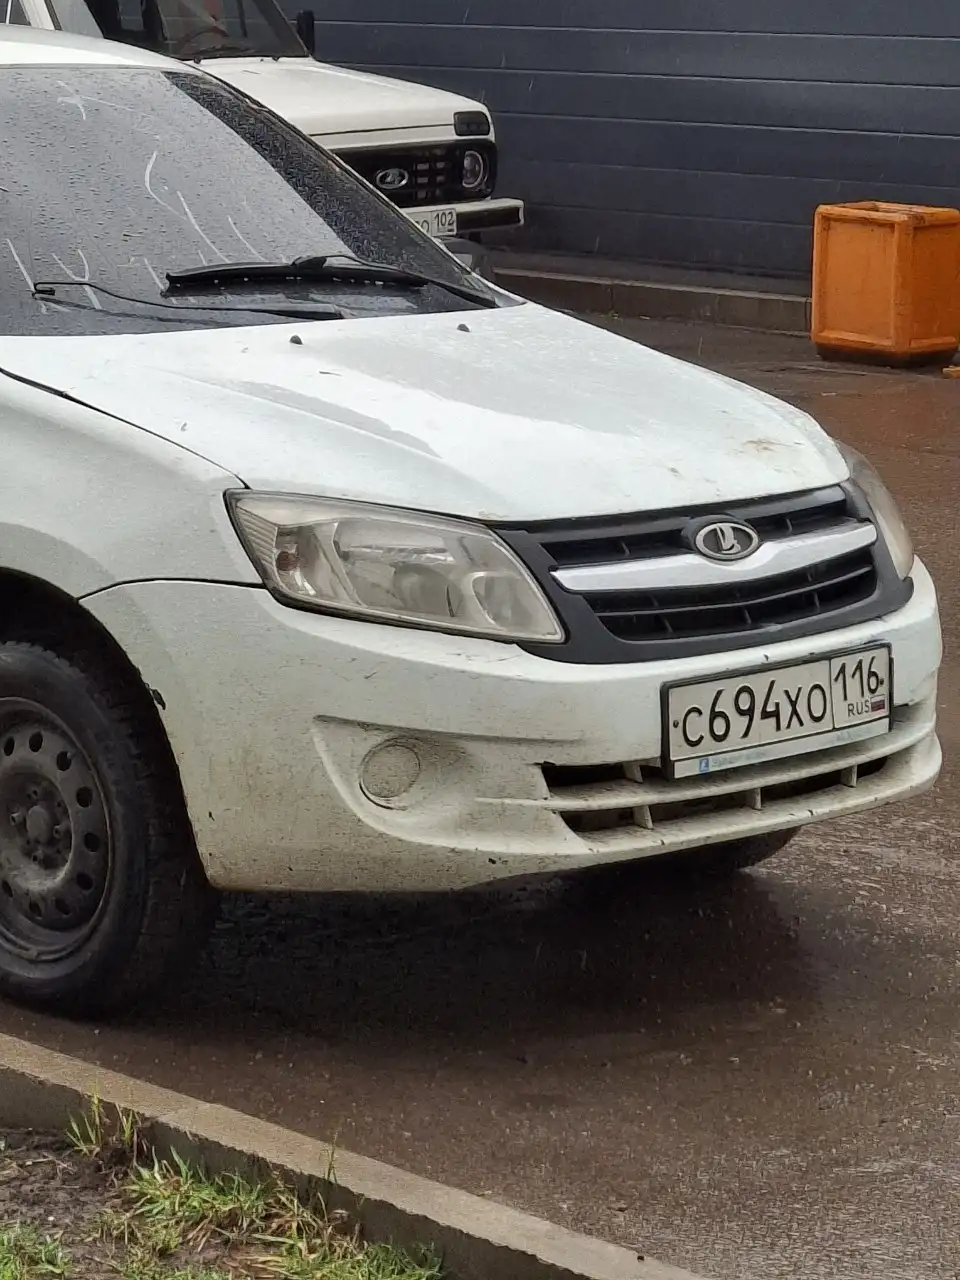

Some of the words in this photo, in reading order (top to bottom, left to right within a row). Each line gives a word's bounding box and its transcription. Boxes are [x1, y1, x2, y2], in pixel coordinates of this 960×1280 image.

[434, 211, 455, 230] 102
[682, 679, 827, 748] С694ХО
[834, 655, 880, 702] 116
[847, 701, 870, 718] RUS
